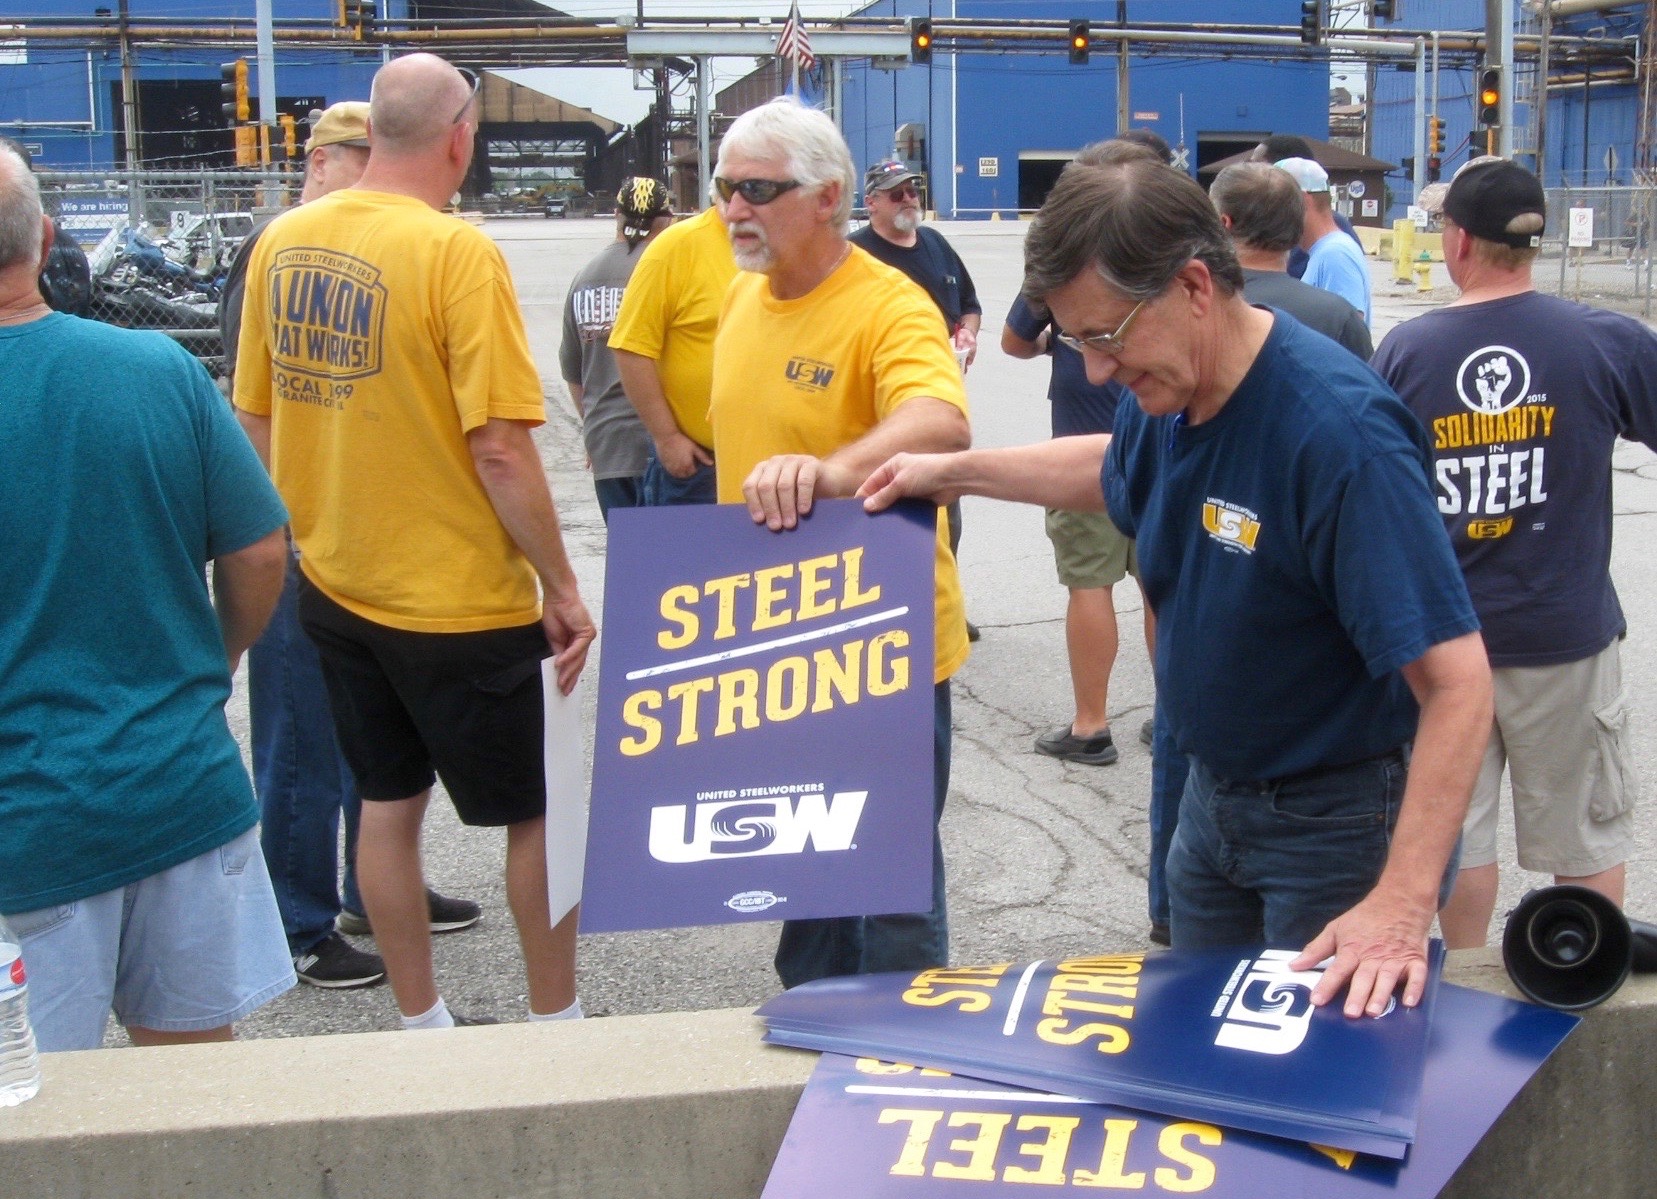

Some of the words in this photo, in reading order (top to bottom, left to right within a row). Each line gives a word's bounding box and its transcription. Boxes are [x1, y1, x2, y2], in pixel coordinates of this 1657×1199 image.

[61, 202, 78, 211] We
[82, 203, 96, 211] are
[99, 202, 129, 213] hiring
[177, 212, 185, 228] 9
[280, 253, 311, 264] UNITED
[313, 254, 371, 279] STEELWORKERS
[785, 360, 835, 388] USW
[277, 388, 322, 406] GRANITE
[1526, 393, 1547, 403] 2015
[1433, 405, 1556, 449] SOLIDARITY
[1489, 443, 1505, 453] IN
[1435, 447, 1548, 514] STEEL
[1202, 502, 1261, 550] USW
[1467, 517, 1513, 539] USW
[657, 546, 881, 651] STEEL
[619, 629, 910, 757] STRONG
[696, 789, 737, 801] UNITED
[739, 782, 825, 798] STEELWORKERS
[648, 790, 869, 864] USW
[902, 963, 1016, 1013] STE
[1036, 953, 1147, 1054] STRON
[877, 1108, 1223, 1193] STEEL
